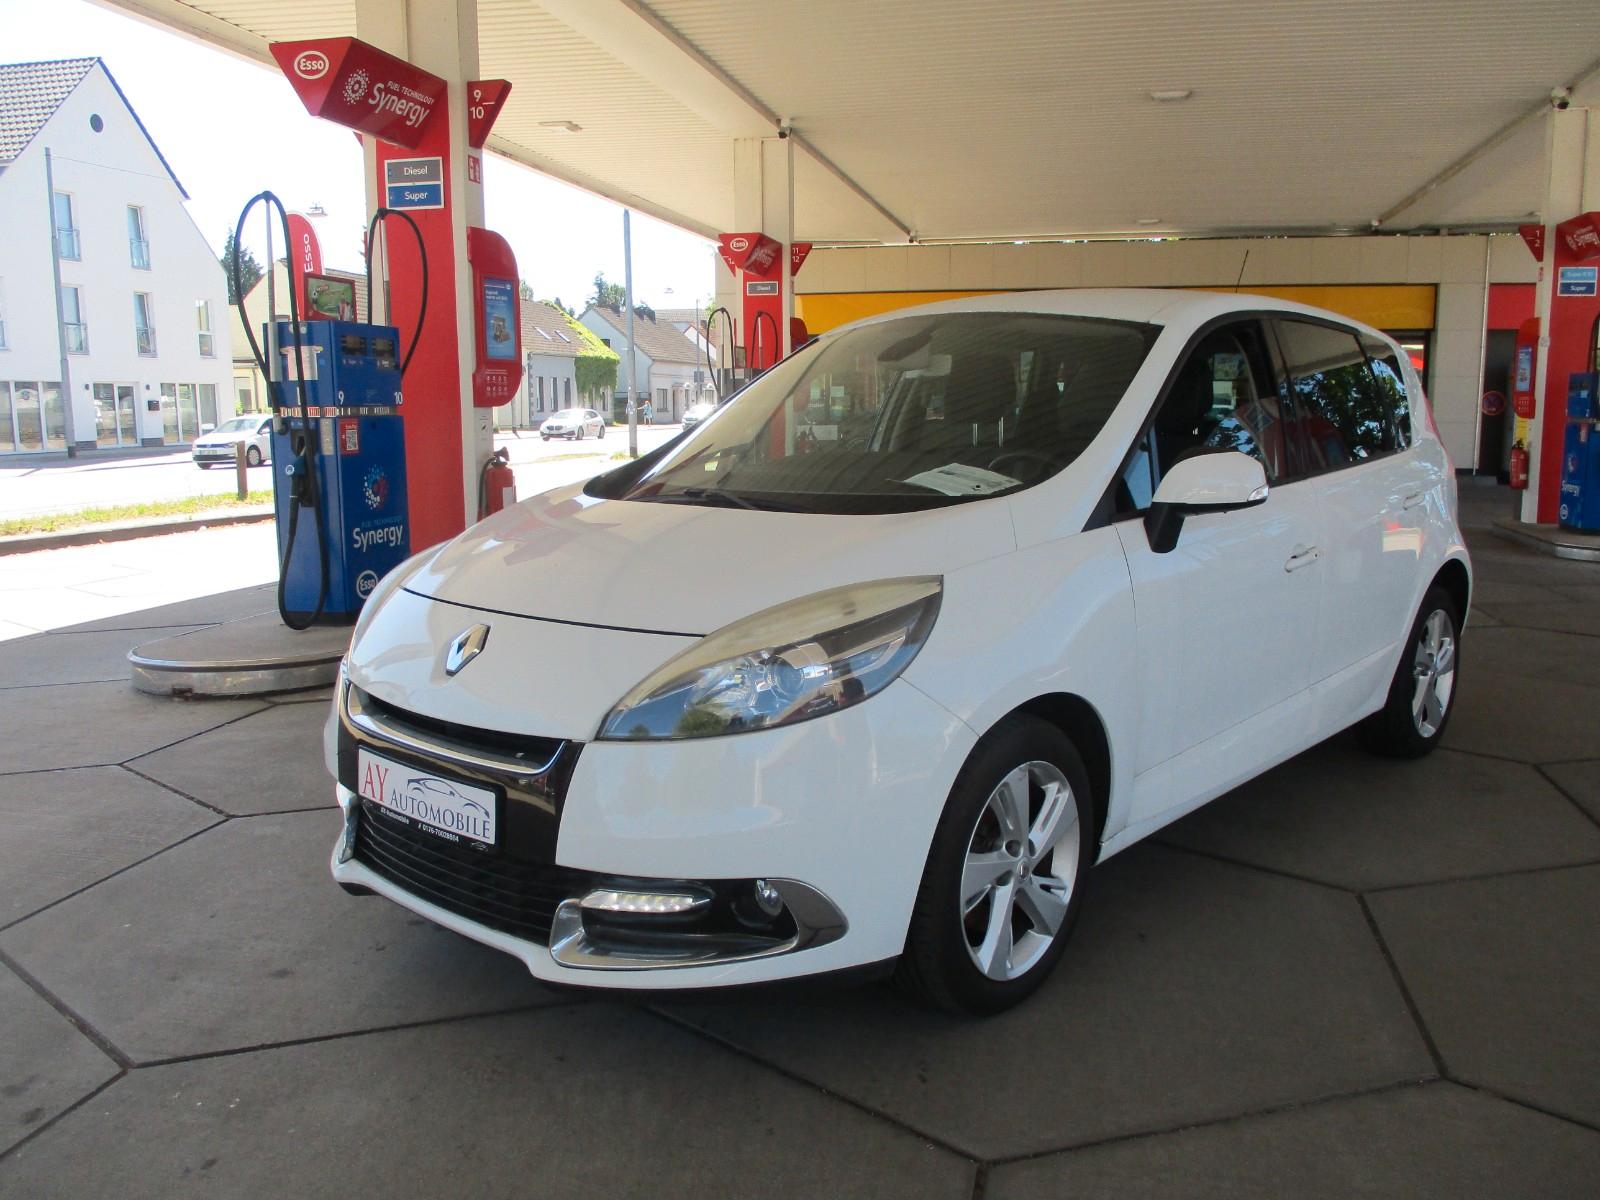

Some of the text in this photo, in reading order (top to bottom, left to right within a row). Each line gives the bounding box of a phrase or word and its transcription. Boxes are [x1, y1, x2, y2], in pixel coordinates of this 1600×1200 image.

[300, 58, 324, 71] Esso
[386, 80, 435, 106] FUEL TECHNOLOGY
[473, 89, 482, 103] 9
[368, 82, 430, 128] Synergy
[469, 106, 485, 120] 10
[403, 165, 428, 176] Diesel
[404, 191, 429, 203] Super
[303, 233, 314, 273] Esso
[791, 247, 799, 255] 11
[791, 255, 800, 263] 12
[338, 390, 345, 405] 9
[393, 391, 404, 405] 10
[352, 525, 403, 553] Synergy
[362, 761, 389, 802] AY
[390, 787, 491, 840] AUTOMOBILE
